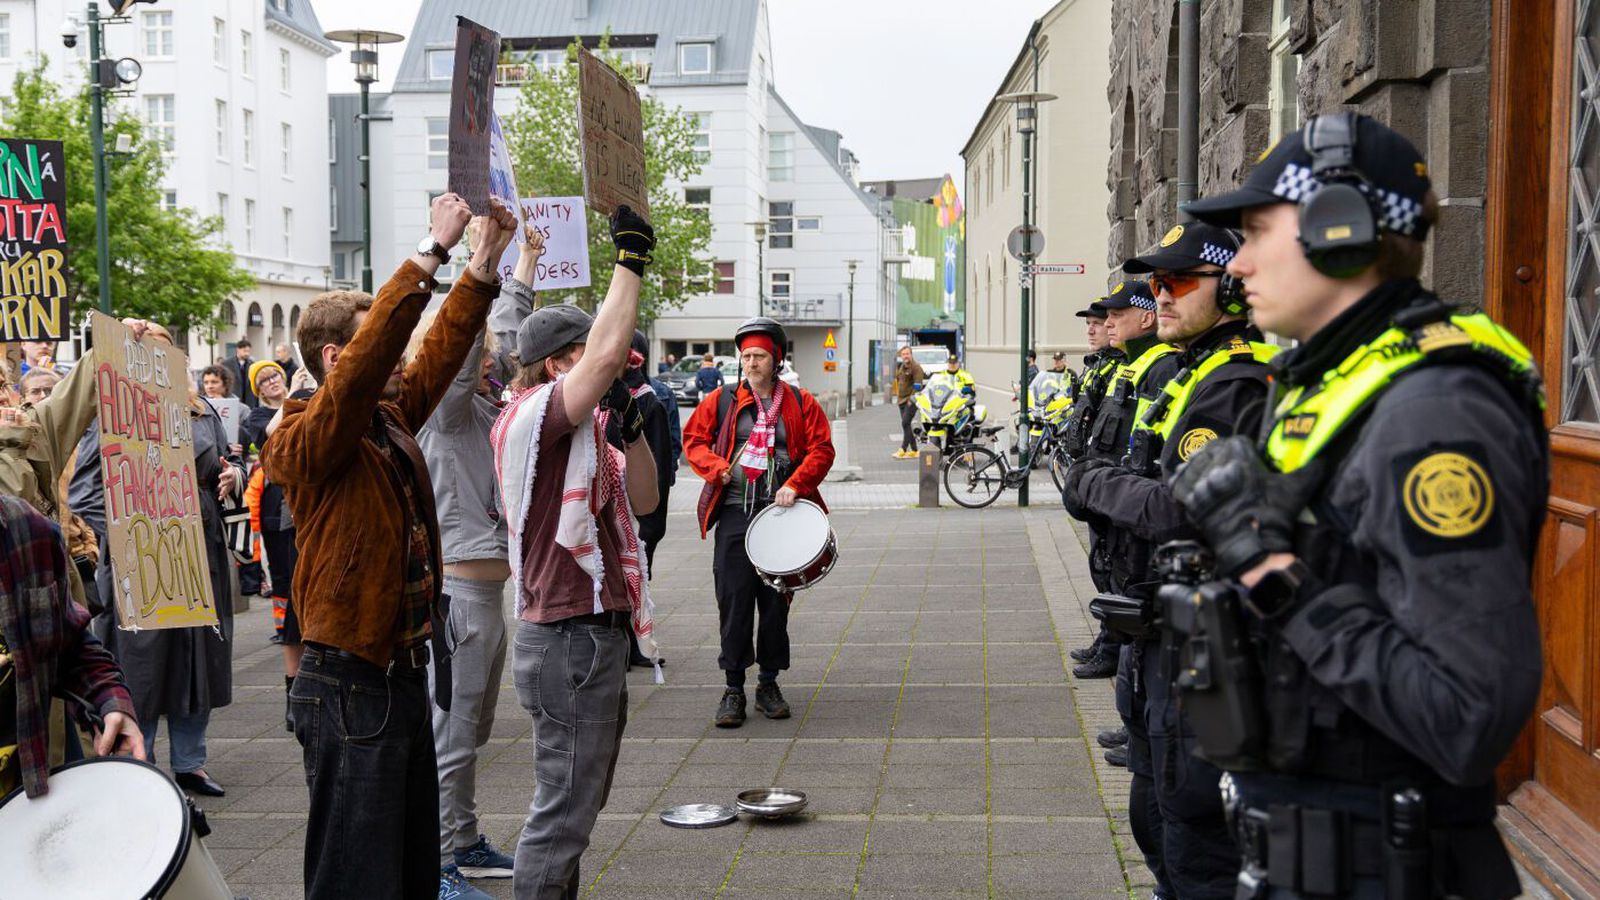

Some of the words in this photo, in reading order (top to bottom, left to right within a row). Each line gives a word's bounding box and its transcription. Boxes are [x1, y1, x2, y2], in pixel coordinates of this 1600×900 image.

[41, 152, 57, 182] Á
[0, 200, 67, 244] TTA
[526, 203, 571, 222] ANITY
[503, 261, 579, 282] BDERS
[0, 295, 61, 340] RN
[128, 512, 209, 618] BÖRN
